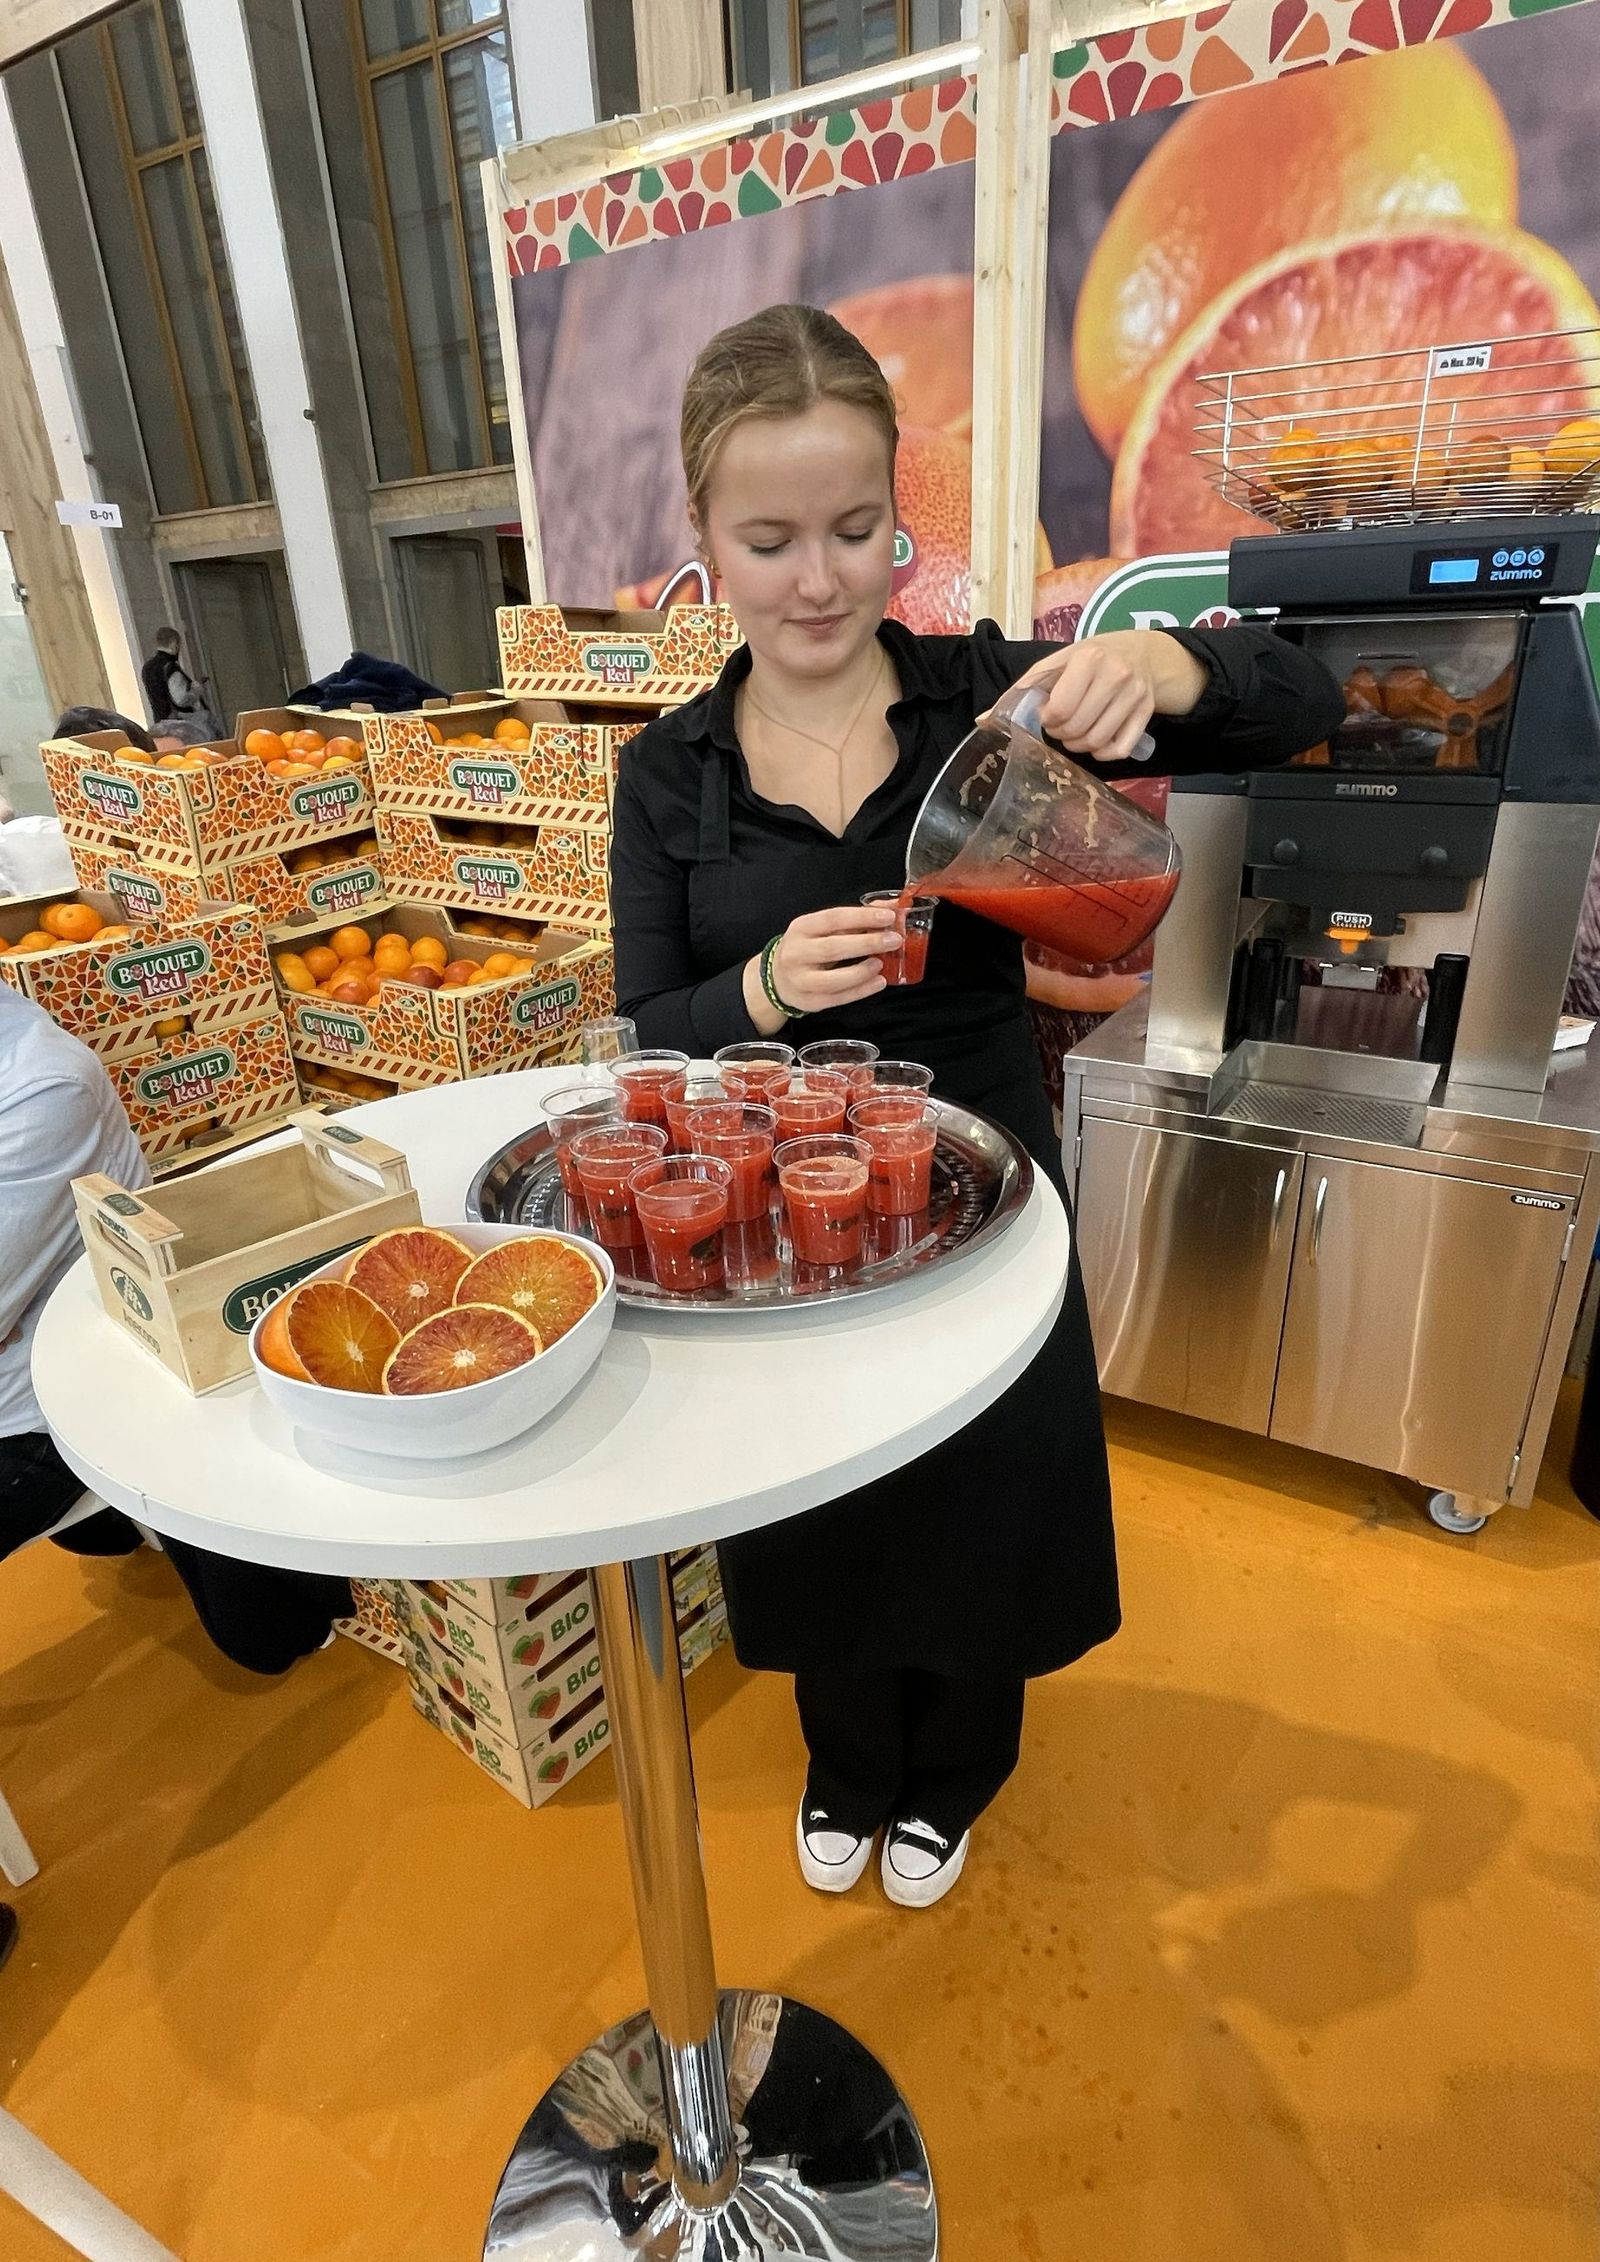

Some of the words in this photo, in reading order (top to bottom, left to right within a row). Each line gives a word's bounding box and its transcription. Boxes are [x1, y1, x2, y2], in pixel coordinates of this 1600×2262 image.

[90, 510, 113, 520] B-01
[1490, 569, 1542, 581] zummo
[590, 653, 646, 668] BOUQUET
[606, 667, 631, 682] Red
[456, 770, 512, 788] BOUQUET
[85, 780, 135, 805] BOUQUET
[299, 785, 355, 812] BOUQUET
[473, 785, 498, 802] Red
[1335, 784, 1398, 796] zummo
[102, 797, 126, 817] Red
[317, 803, 343, 822] Red
[461, 866, 516, 884] BOUQUET
[111, 877, 157, 902] BOUQUET
[315, 874, 370, 903] BOUQUET
[478, 881, 502, 898] Red
[334, 893, 359, 911] Red
[1336, 915, 1367, 925] PUSH
[117, 949, 199, 985] BOUQUET
[144, 972, 183, 996] Red
[521, 986, 574, 1019] BOUQUET
[537, 1006, 560, 1029] Red
[304, 1016, 360, 1041] BOUQUET
[322, 1034, 349, 1053] Red
[147, 1056, 225, 1096] BOUQUET
[173, 1078, 210, 1103] Red
[1515, 1195, 1560, 1209] zummo
[551, 1602, 589, 1642] BIO
[447, 1618, 475, 1648] BIO
[567, 1656, 601, 1695] BIO
[574, 1719, 609, 1759] BIO
